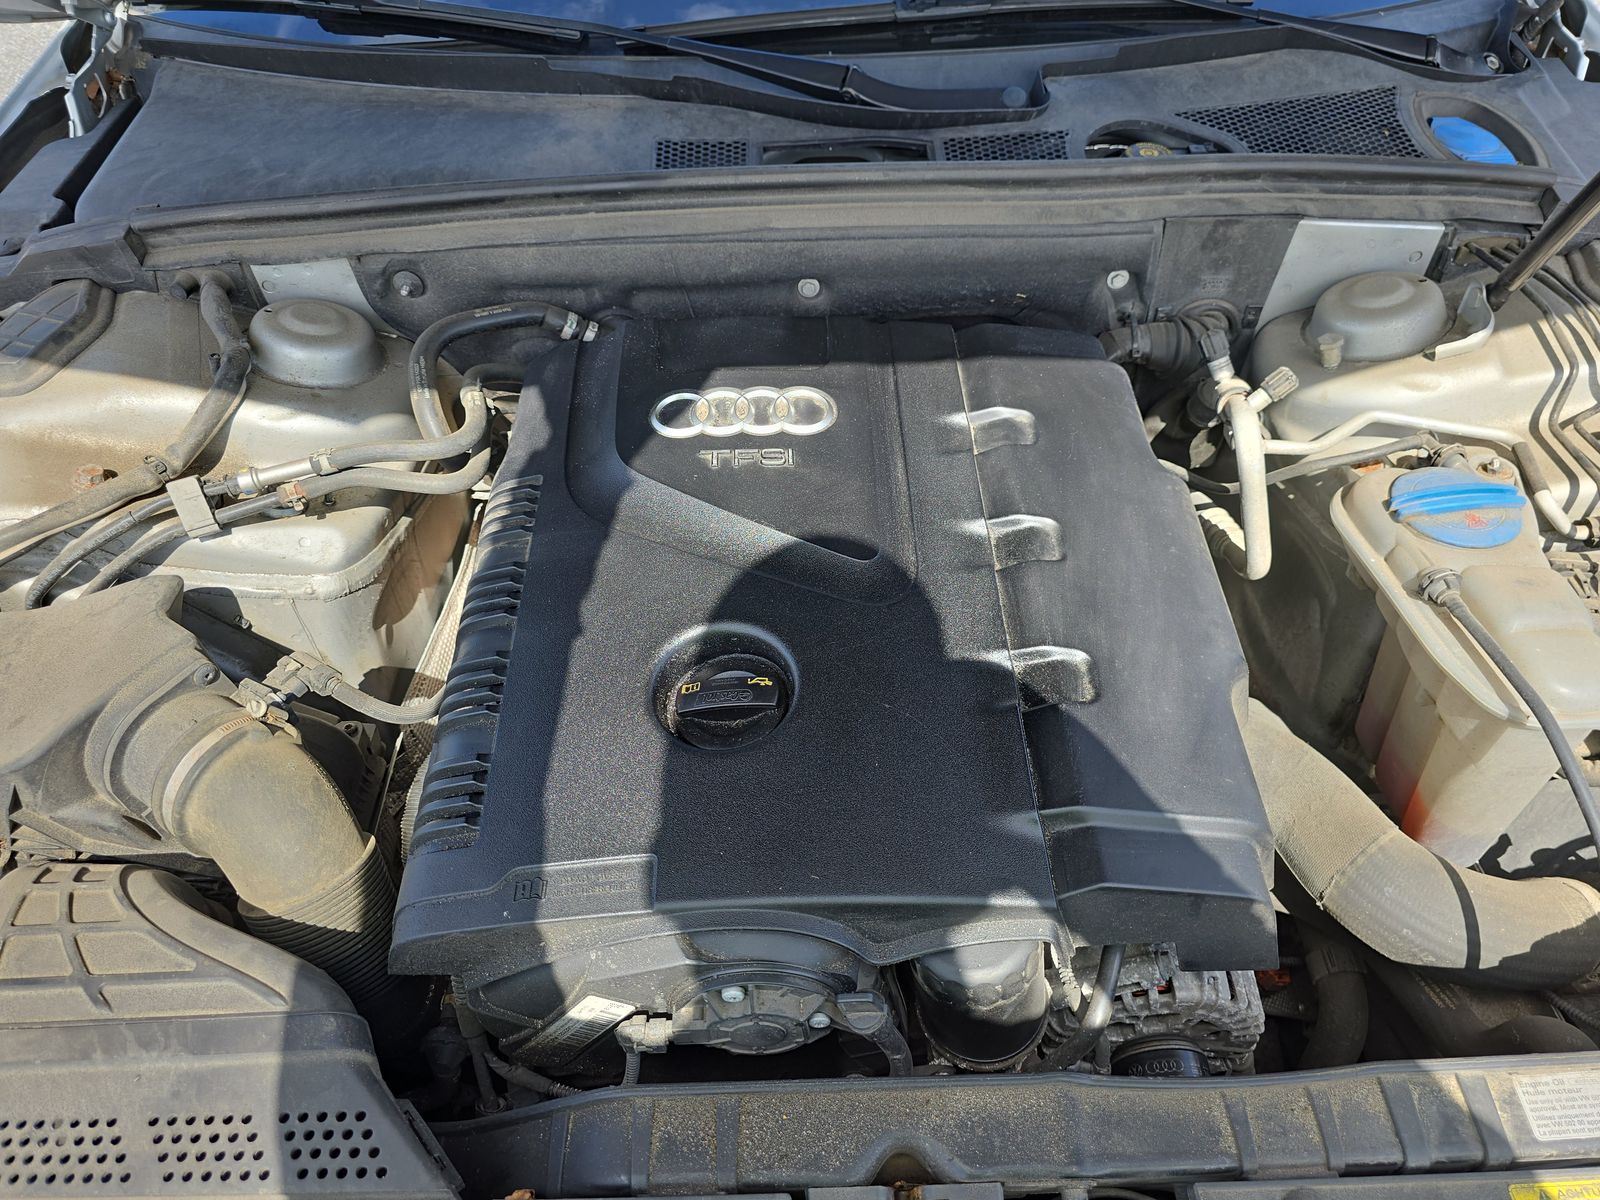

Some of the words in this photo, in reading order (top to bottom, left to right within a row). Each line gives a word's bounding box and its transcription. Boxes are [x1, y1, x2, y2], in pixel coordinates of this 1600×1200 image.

[699, 448, 795, 468] TFSI
[1519, 1080, 1550, 1089] Engine
[1552, 1078, 1565, 1086] Oil
[1522, 1089, 1546, 1097] Huile
[1548, 1087, 1583, 1096] moteur
